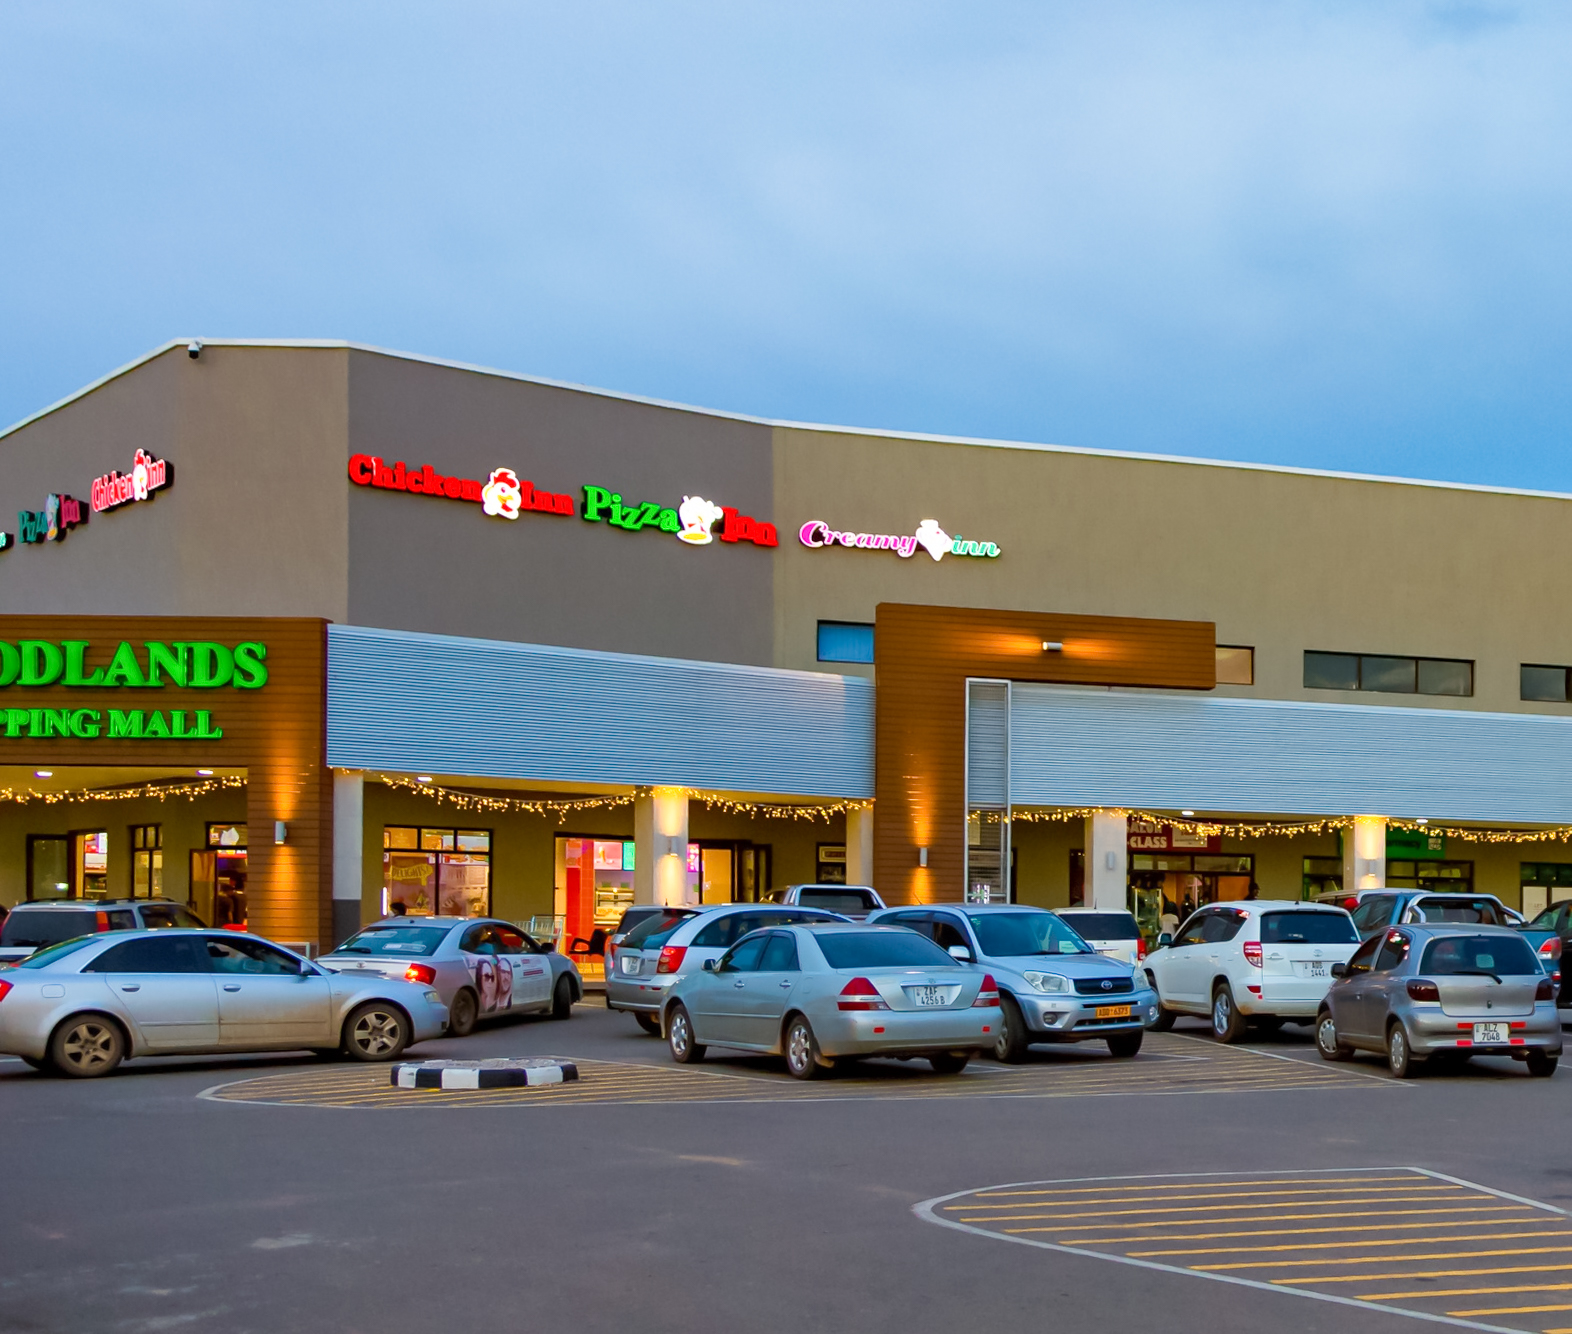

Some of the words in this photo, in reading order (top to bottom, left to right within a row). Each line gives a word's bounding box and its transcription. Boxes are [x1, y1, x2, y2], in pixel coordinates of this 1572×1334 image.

[91, 470, 134, 512] Chicken
[349, 453, 482, 502] Chicken
[520, 481, 575, 516] Inn
[583, 485, 680, 532] Pizza
[721, 507, 778, 547] Inn
[799, 520, 916, 557] Creamy
[952, 534, 1000, 557] inn
[106, 709, 223, 739] MALL
[1481, 1032, 1501, 1041] 7048
[1483, 1023, 1498, 1033] ALZ
